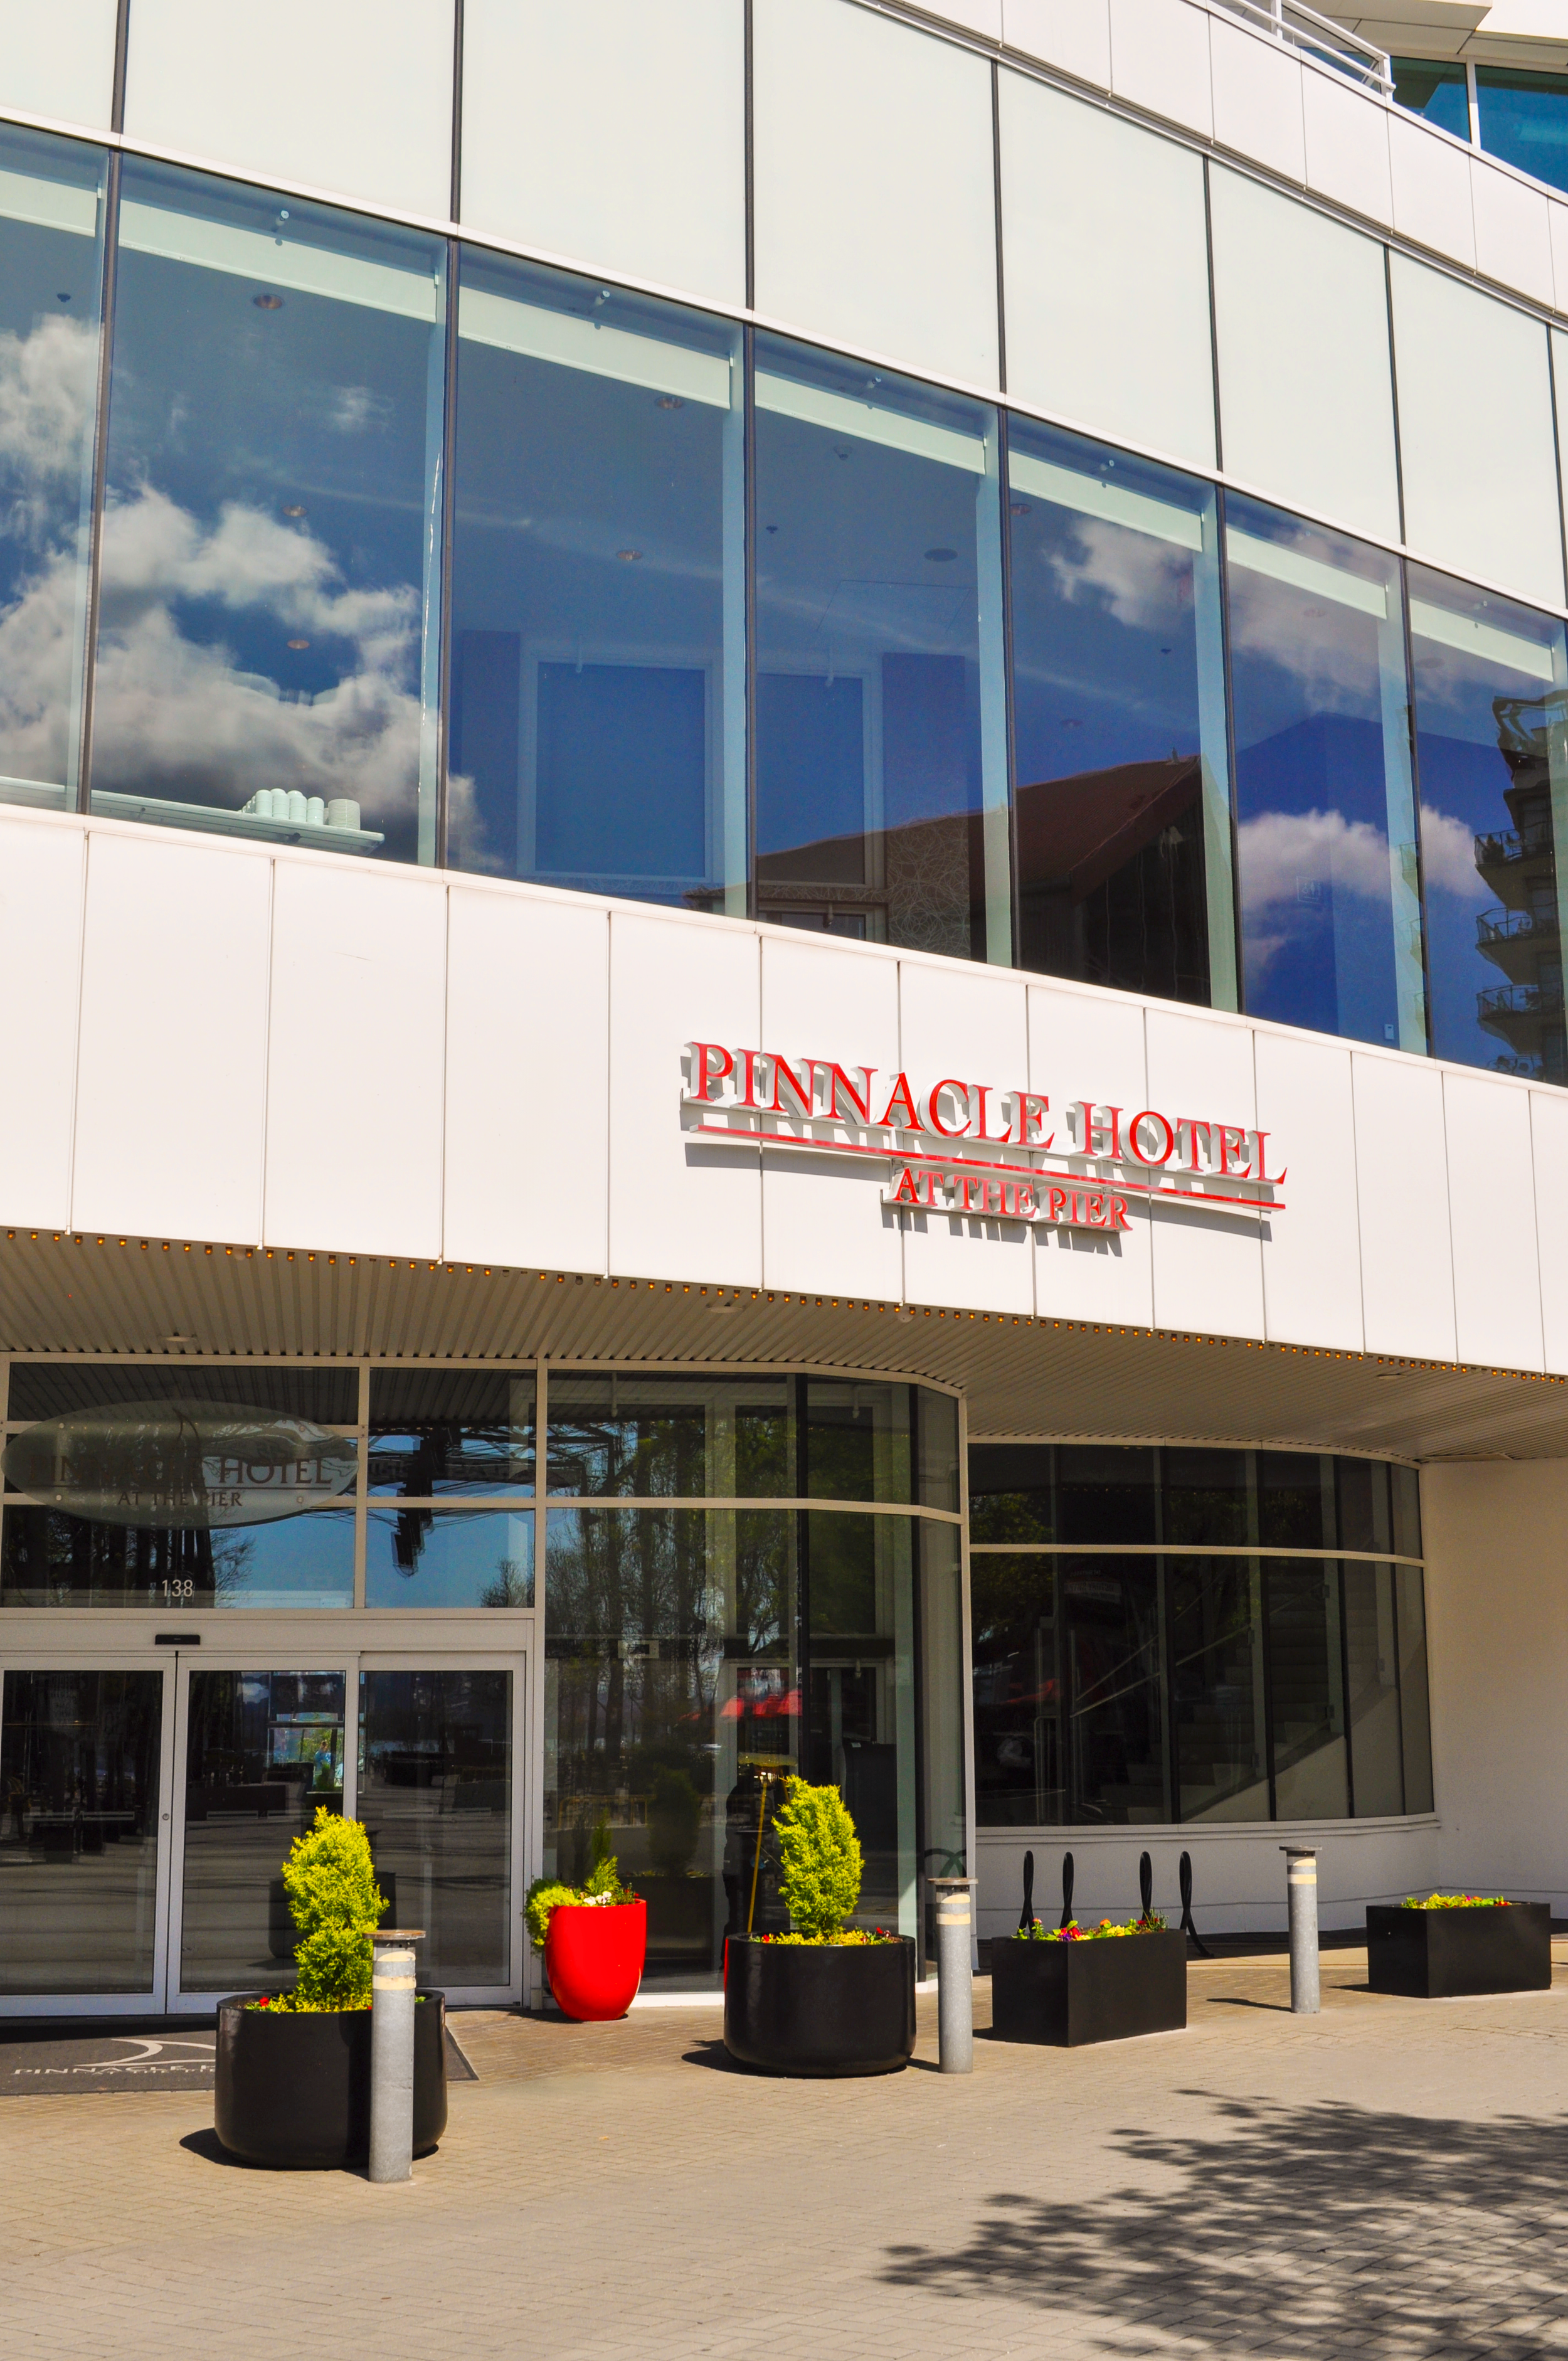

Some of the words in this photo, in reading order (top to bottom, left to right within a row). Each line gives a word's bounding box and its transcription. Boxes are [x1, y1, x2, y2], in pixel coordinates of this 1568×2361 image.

[686, 1041, 1056, 1150] PINNACLE
[1071, 1101, 1287, 1185] HOTEL
[891, 1167, 944, 1207] AT
[951, 1174, 1037, 1218] THE
[1044, 1187, 1133, 1231] PIER
[28, 1455, 205, 1484] PINNACLE
[219, 1456, 332, 1485] HOTEL
[117, 1491, 142, 1506] AT
[152, 1491, 188, 1506] THE
[199, 1491, 243, 1507] PIER
[162, 1579, 193, 1597] 138
